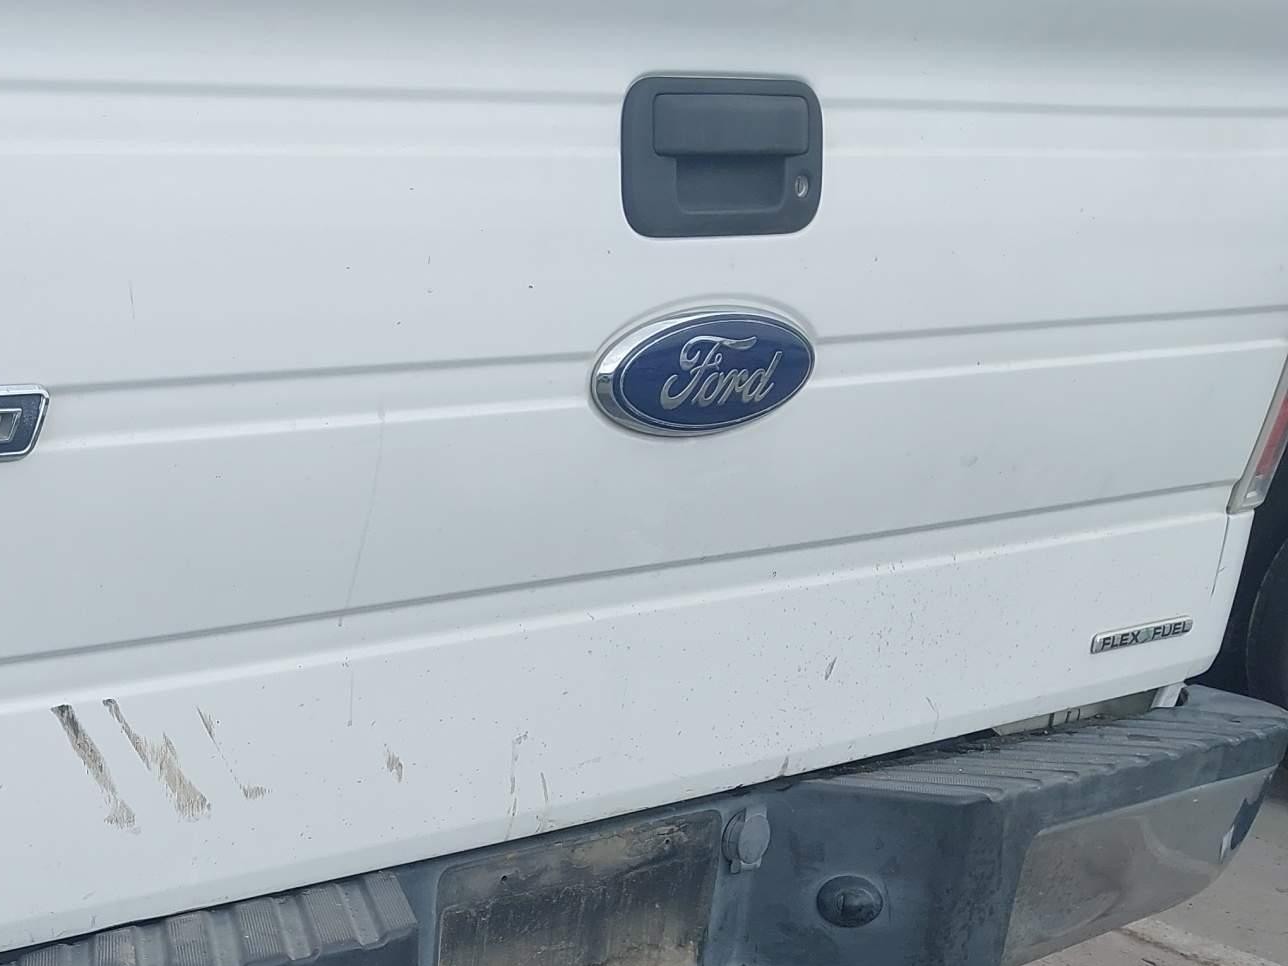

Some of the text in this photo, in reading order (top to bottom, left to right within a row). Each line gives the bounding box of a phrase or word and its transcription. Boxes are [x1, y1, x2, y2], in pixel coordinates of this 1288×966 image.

[660, 335, 782, 410] Ford
[1101, 620, 1190, 651] FLEX FUEL
